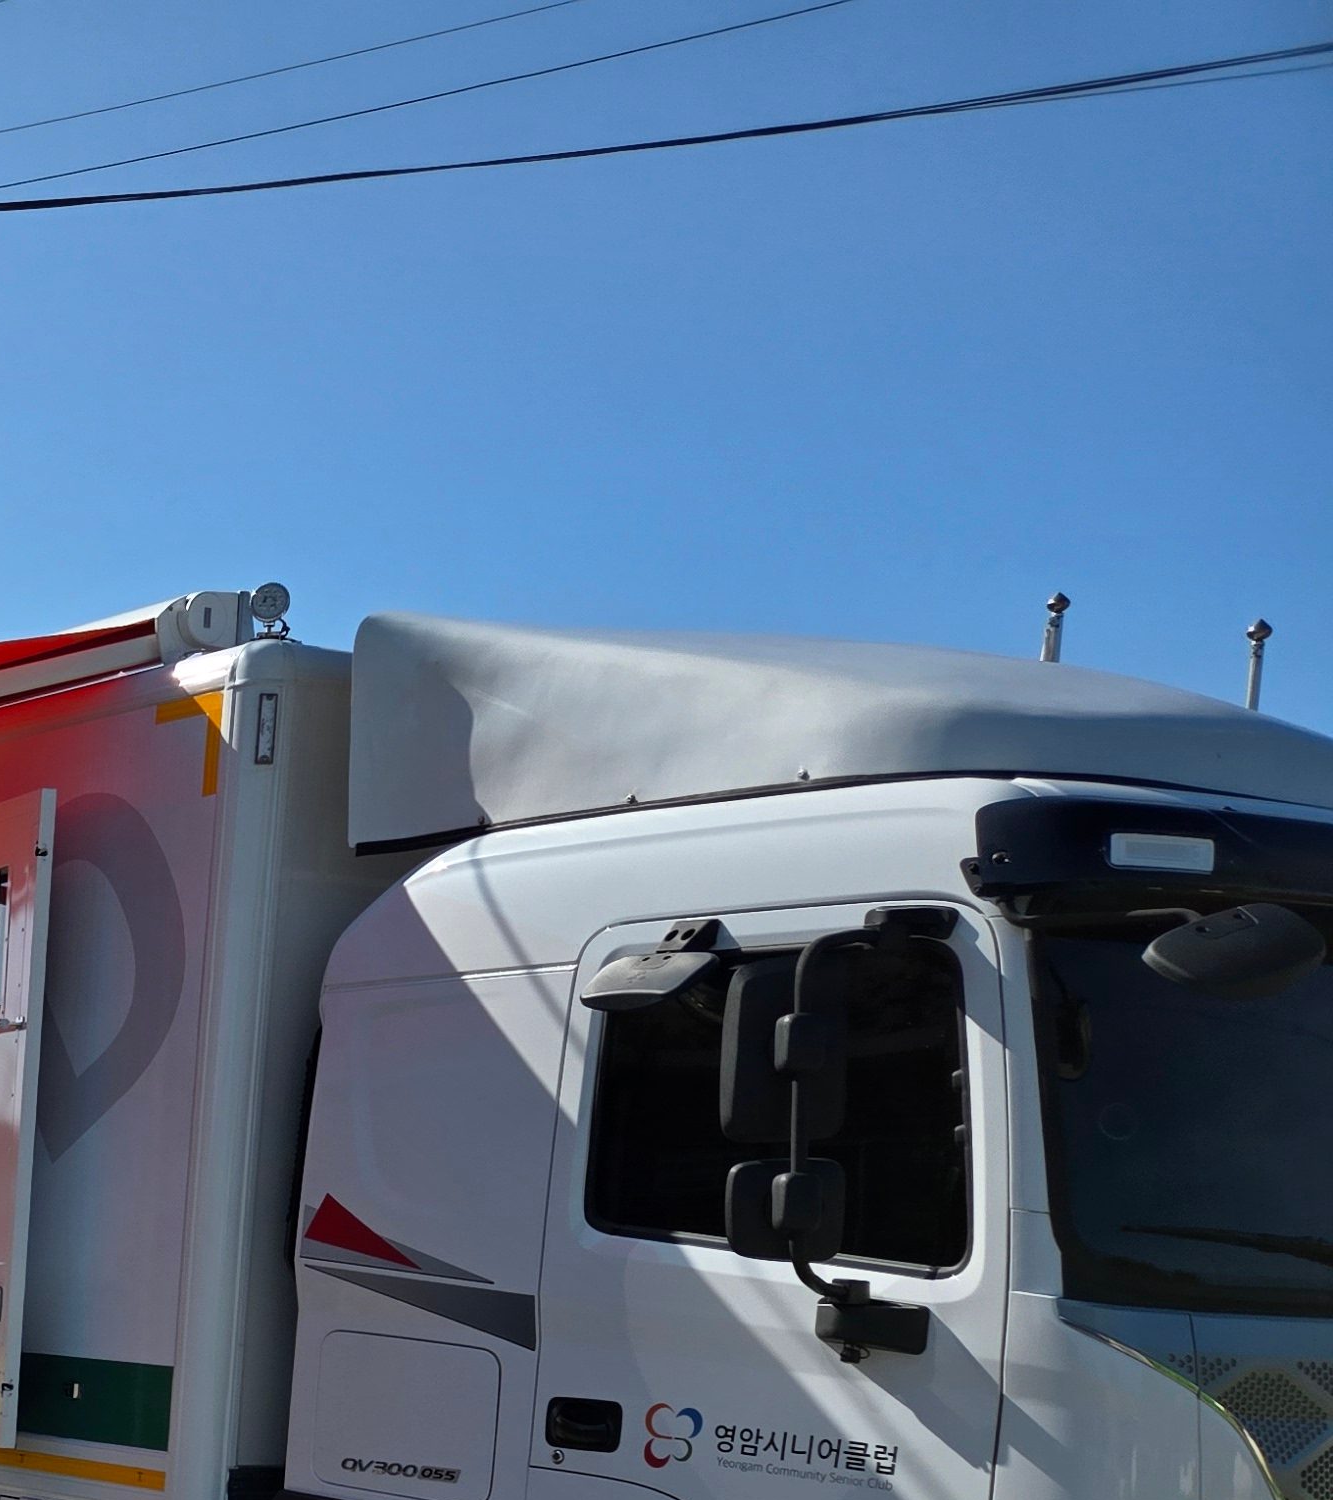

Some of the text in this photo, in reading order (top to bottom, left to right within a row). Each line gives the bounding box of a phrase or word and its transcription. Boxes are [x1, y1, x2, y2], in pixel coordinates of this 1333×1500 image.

[714, 1424, 899, 1476] 영암시니어클럽
[717, 1456, 894, 1491] Yeongam Community Senior Club
